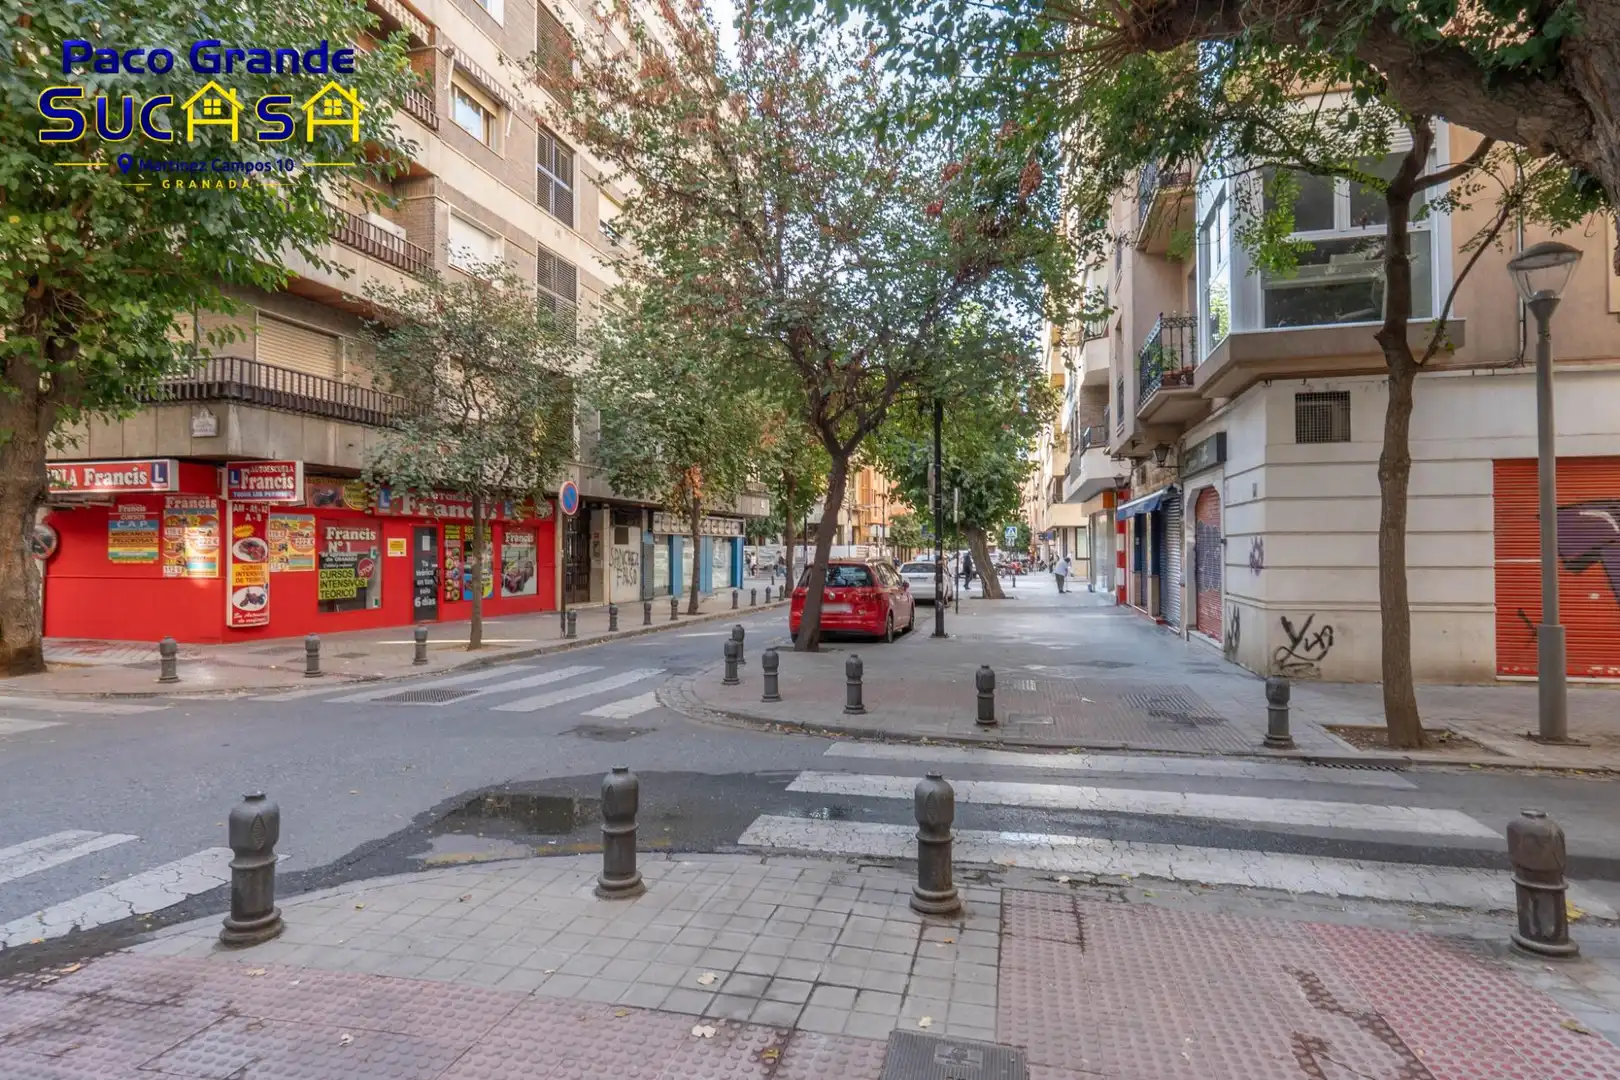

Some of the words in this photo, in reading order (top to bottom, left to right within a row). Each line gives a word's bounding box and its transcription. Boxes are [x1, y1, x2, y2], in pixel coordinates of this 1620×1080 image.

[84, 467, 148, 487] Francis
[154, 463, 164, 482] L
[230, 470, 239, 484] L
[240, 468, 294, 490] Francis
[165, 495, 217, 508] Francis
[326, 527, 377, 541] Francis
[505, 532, 534, 543] Francis
[320, 569, 354, 579] CURSOS
[359, 563, 374, 577] STOP
